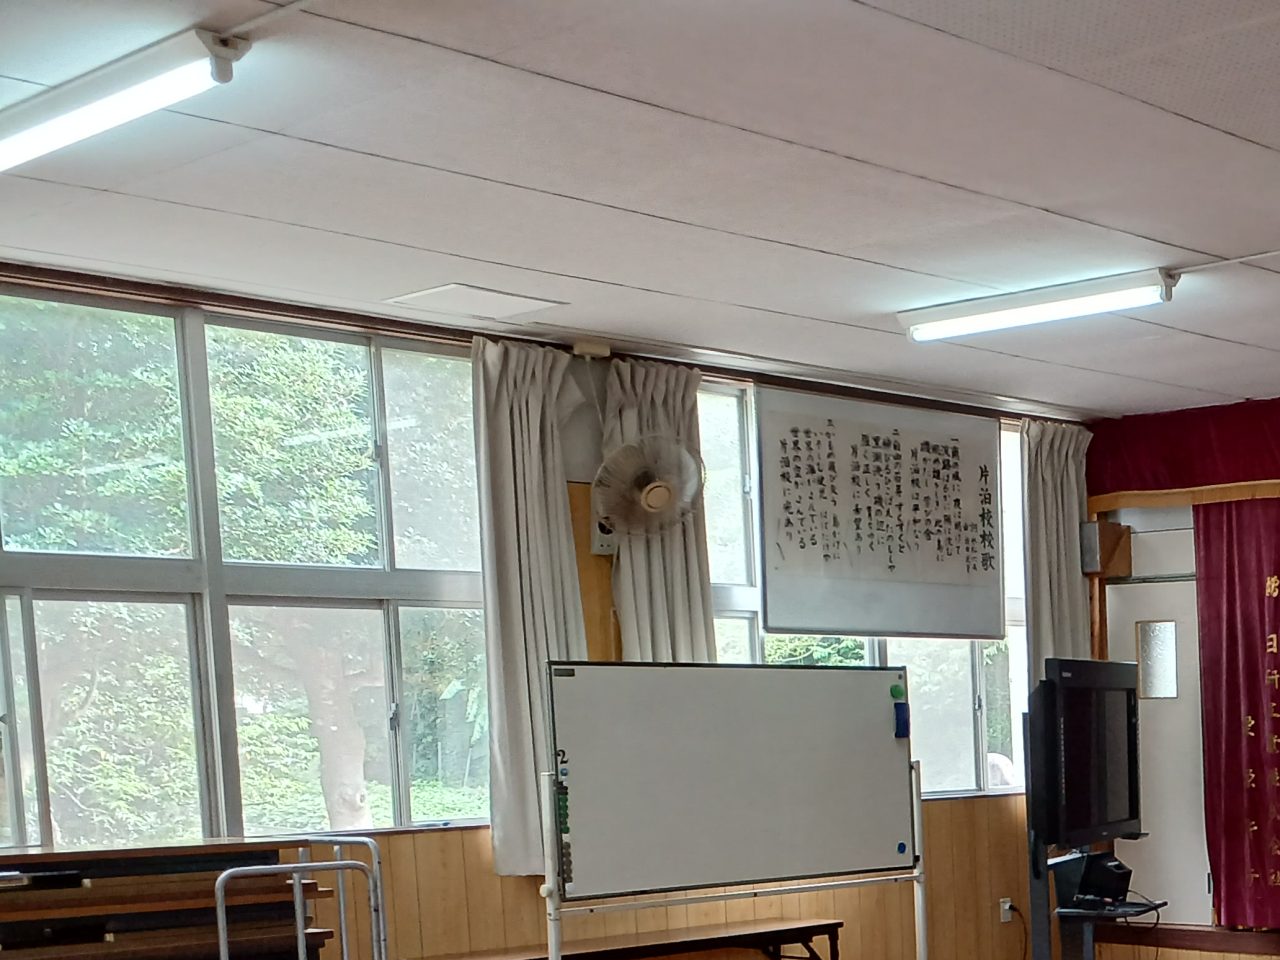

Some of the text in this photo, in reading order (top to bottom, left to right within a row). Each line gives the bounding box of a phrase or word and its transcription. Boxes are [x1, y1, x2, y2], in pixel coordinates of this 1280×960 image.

[978, 464, 996, 573] 片泊校校歌
